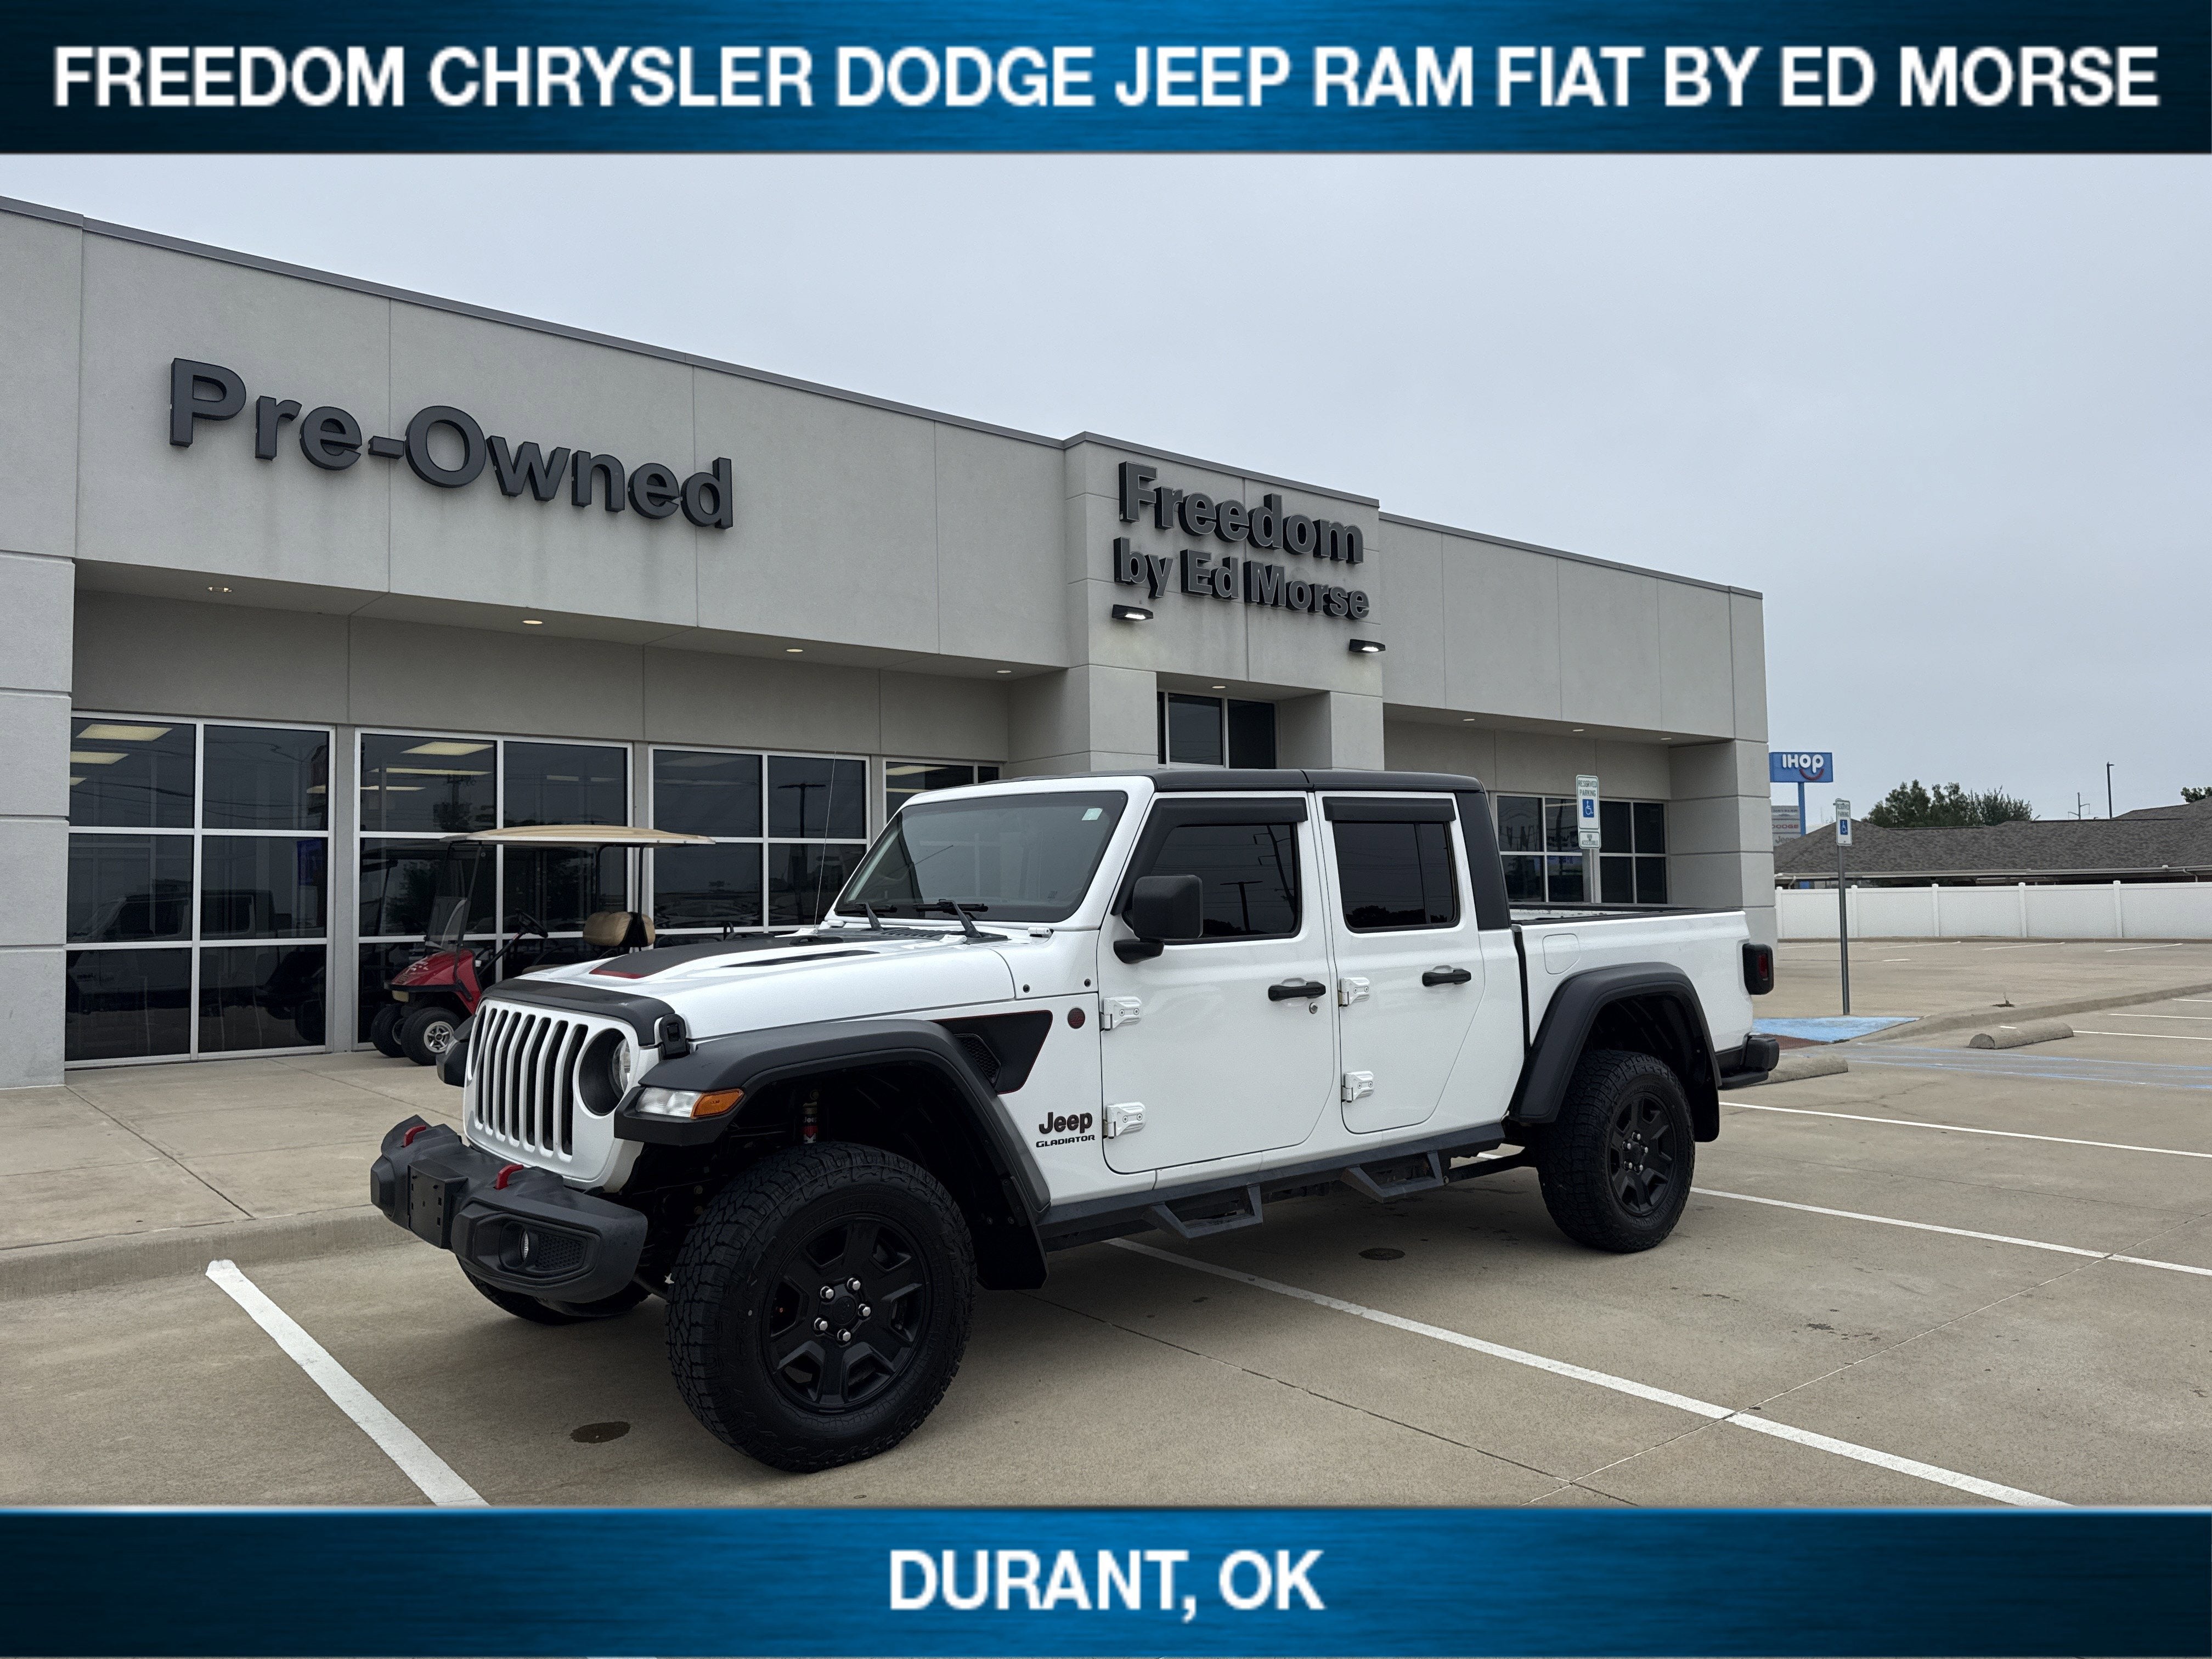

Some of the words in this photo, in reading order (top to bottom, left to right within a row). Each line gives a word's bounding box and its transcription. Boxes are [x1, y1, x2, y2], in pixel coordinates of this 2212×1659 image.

[170, 357, 733, 529] Pre-Owned
[1119, 461, 1364, 565] Freedom
[1114, 537, 1173, 599] by
[1181, 549, 1239, 599] Ed
[1244, 561, 1370, 620] Morse
[1578, 780, 1598, 788] RESERVED
[1036, 1135, 1096, 1148] GLADIATOR
[1039, 1111, 1093, 1134] Jeep
